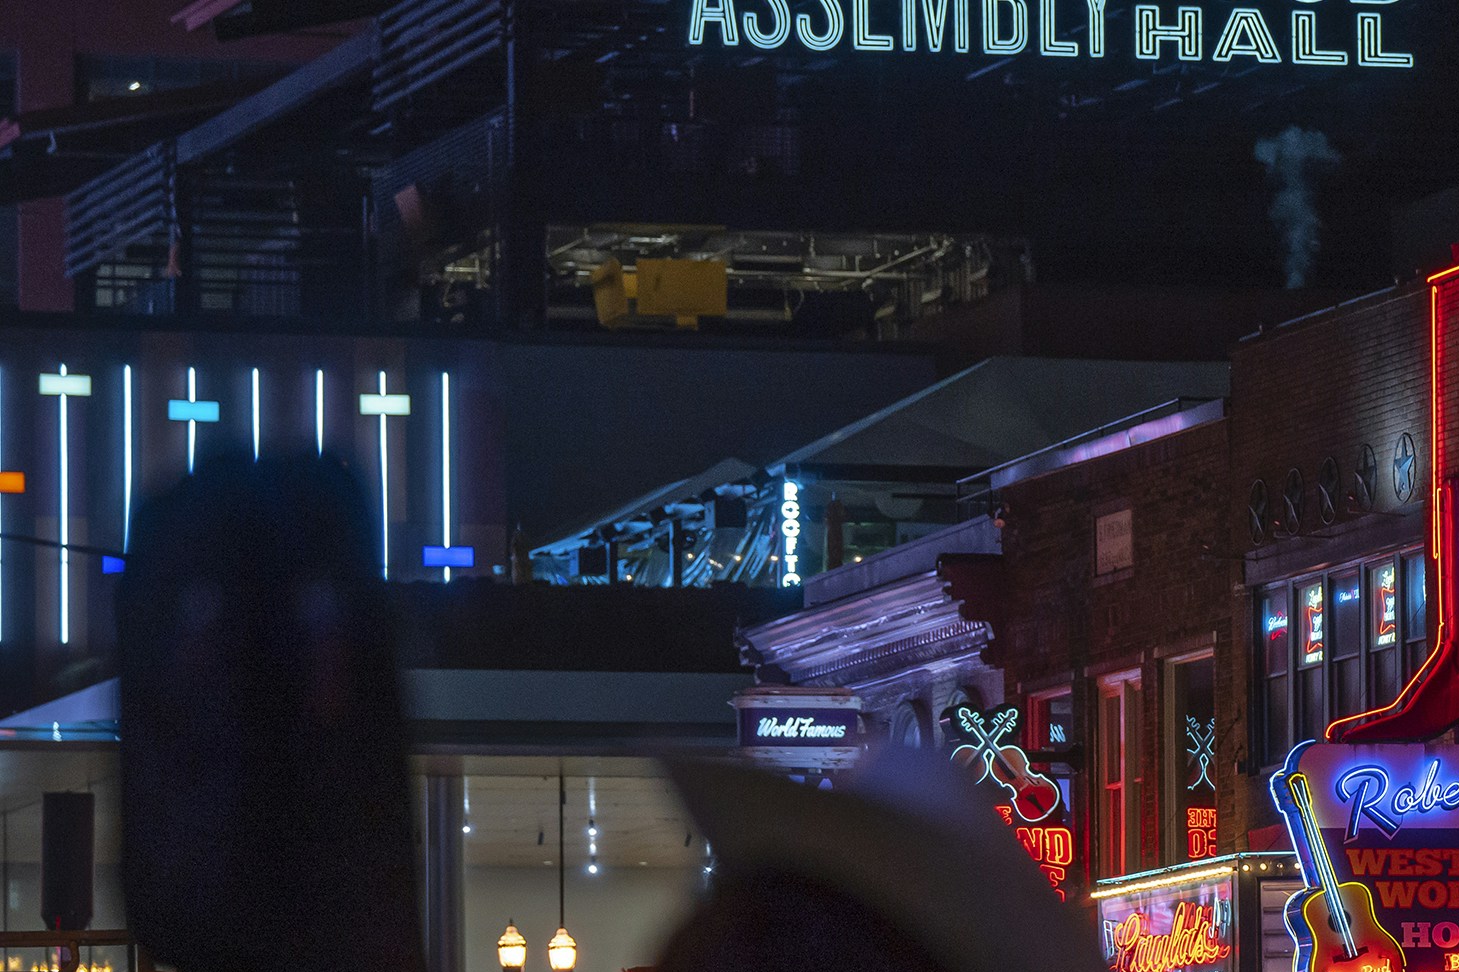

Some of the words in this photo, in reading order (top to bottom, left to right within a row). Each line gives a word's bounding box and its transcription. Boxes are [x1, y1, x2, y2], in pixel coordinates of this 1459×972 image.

[689, 0, 1106, 57] ASSEMBLY
[1135, 6, 1414, 67] HALL
[757, 717, 799, 737] World
[798, 717, 847, 738] Famous
